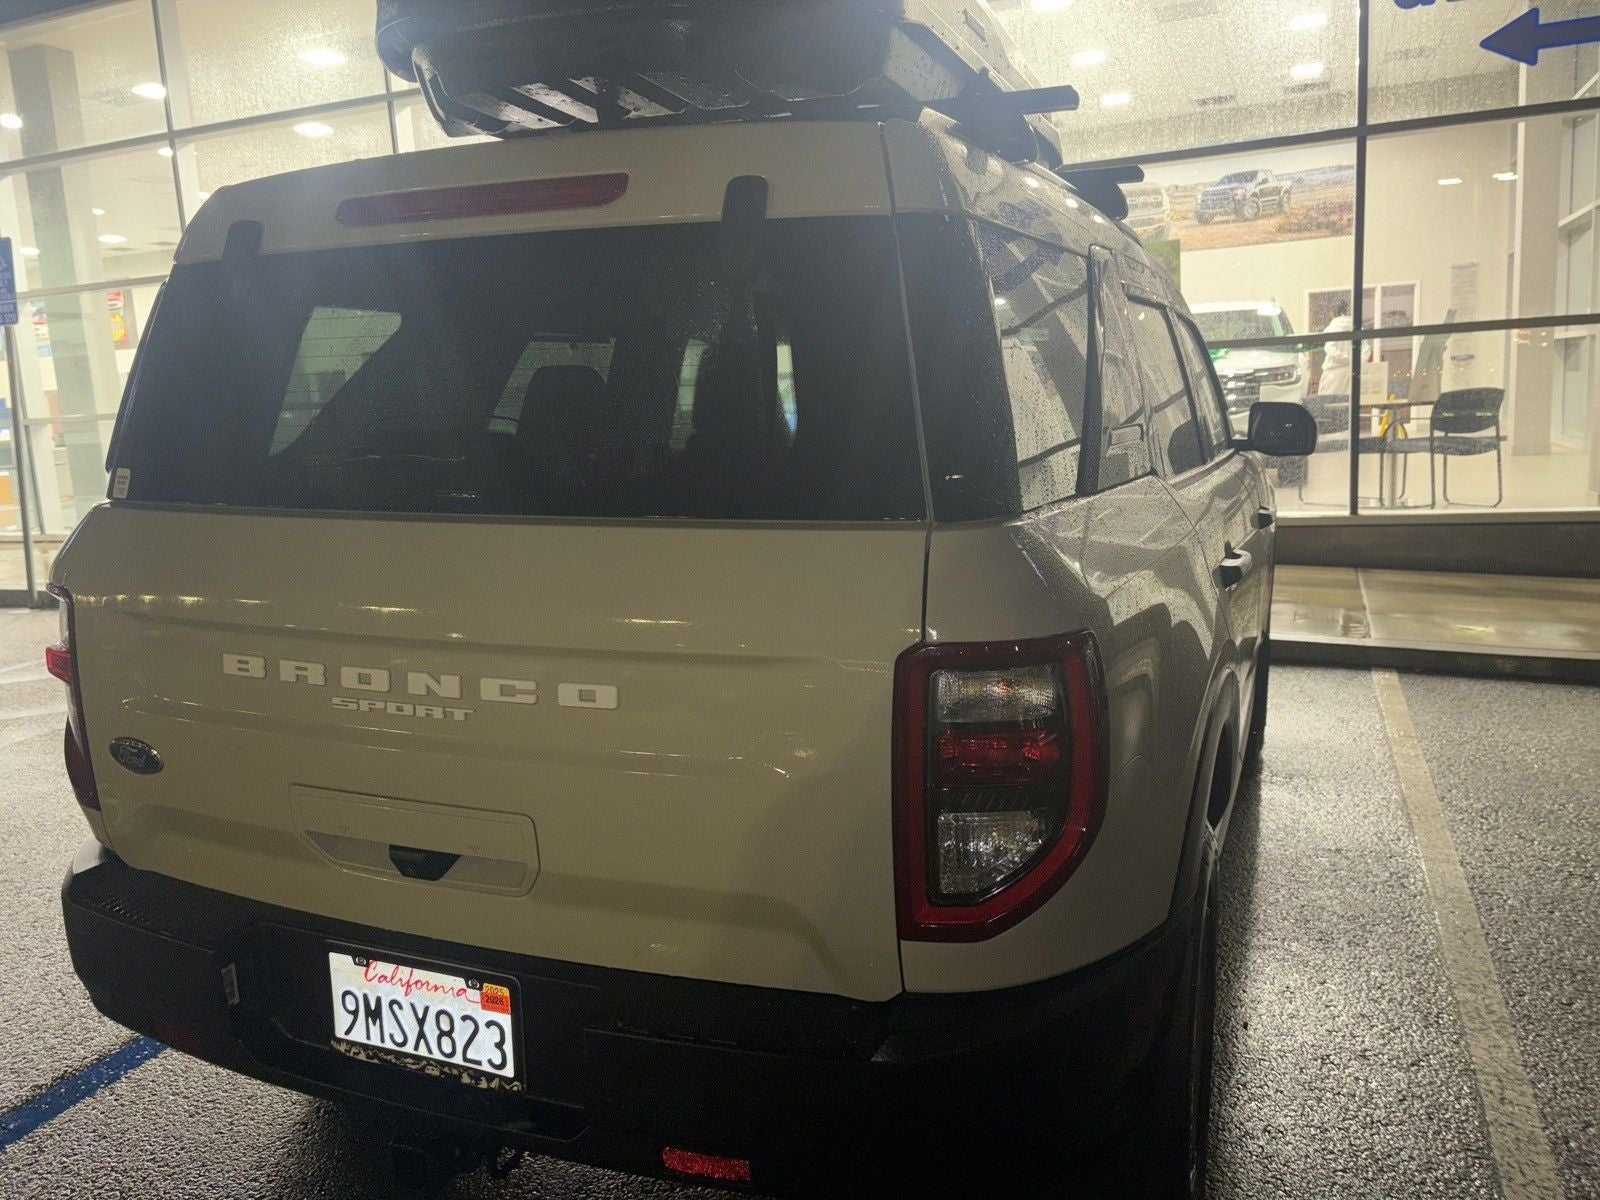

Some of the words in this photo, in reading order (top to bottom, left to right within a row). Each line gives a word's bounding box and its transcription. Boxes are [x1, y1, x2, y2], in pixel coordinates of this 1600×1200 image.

[223, 653, 619, 709] BRONCO
[331, 696, 475, 721] SPORT
[363, 959, 471, 998] California
[341, 990, 508, 1071] 9MSX823
